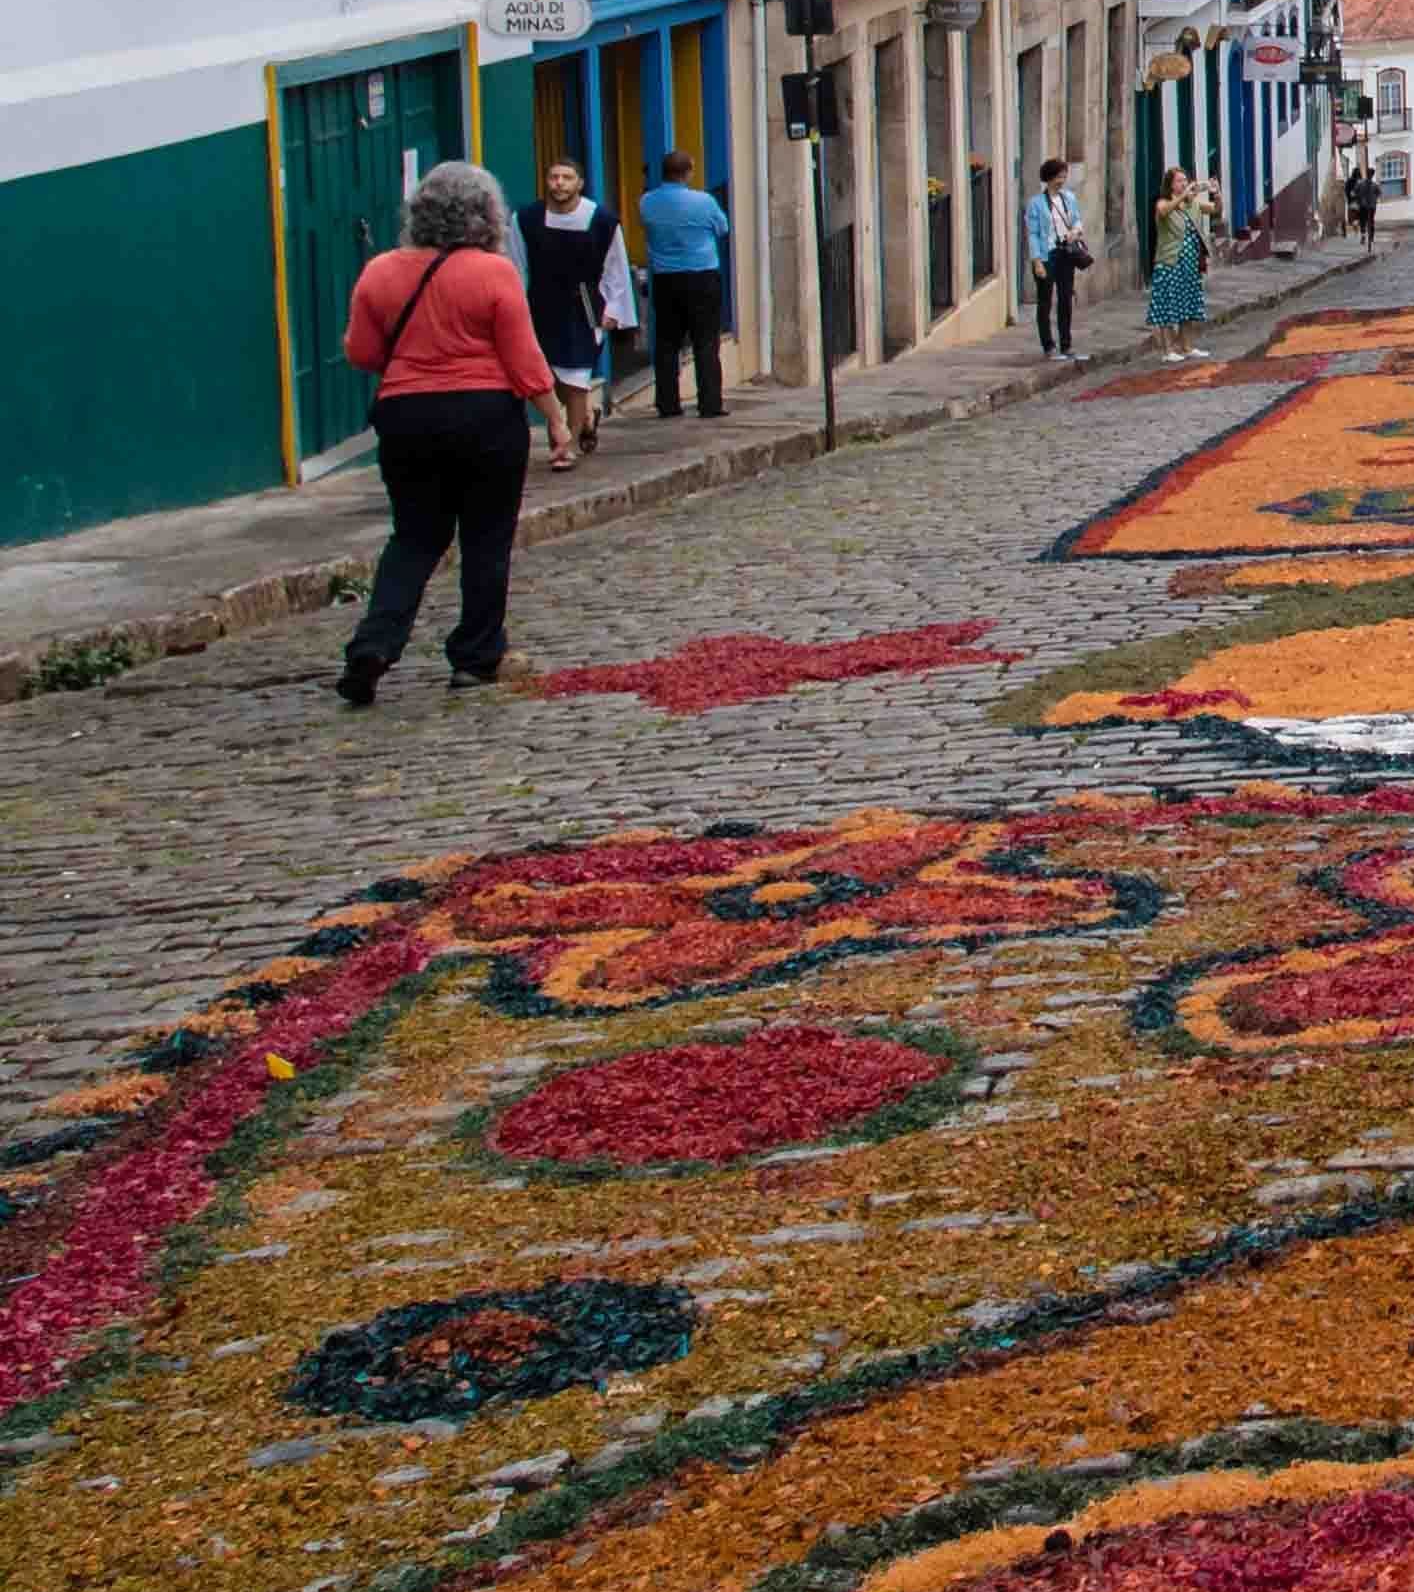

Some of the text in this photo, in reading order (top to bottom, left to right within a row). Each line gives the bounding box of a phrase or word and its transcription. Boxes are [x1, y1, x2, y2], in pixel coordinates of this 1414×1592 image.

[504, 1, 564, 18] AQUI DI
[506, 16, 565, 33] MINAS
